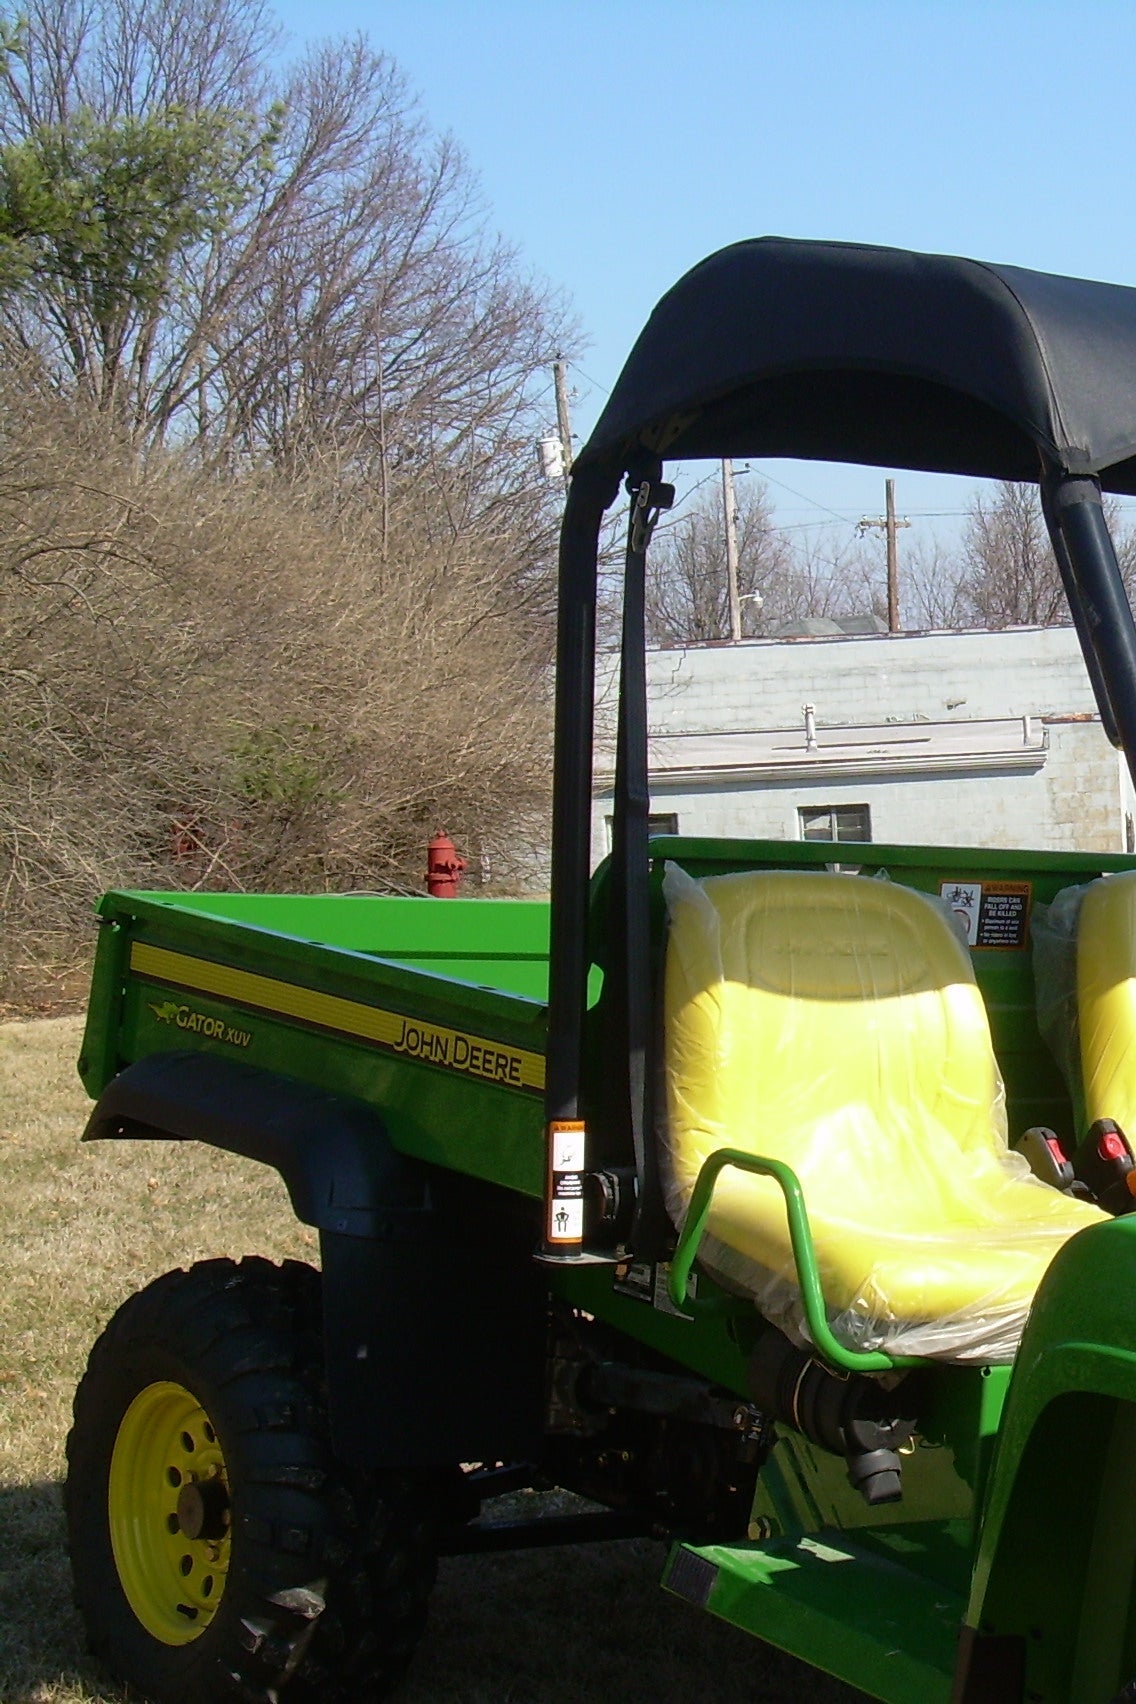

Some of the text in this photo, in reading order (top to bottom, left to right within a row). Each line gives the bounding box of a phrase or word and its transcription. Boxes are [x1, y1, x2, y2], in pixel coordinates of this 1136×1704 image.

[176, 1005, 251, 1047] GATOR XUV
[393, 1019, 523, 1083] JOHN DEERE
